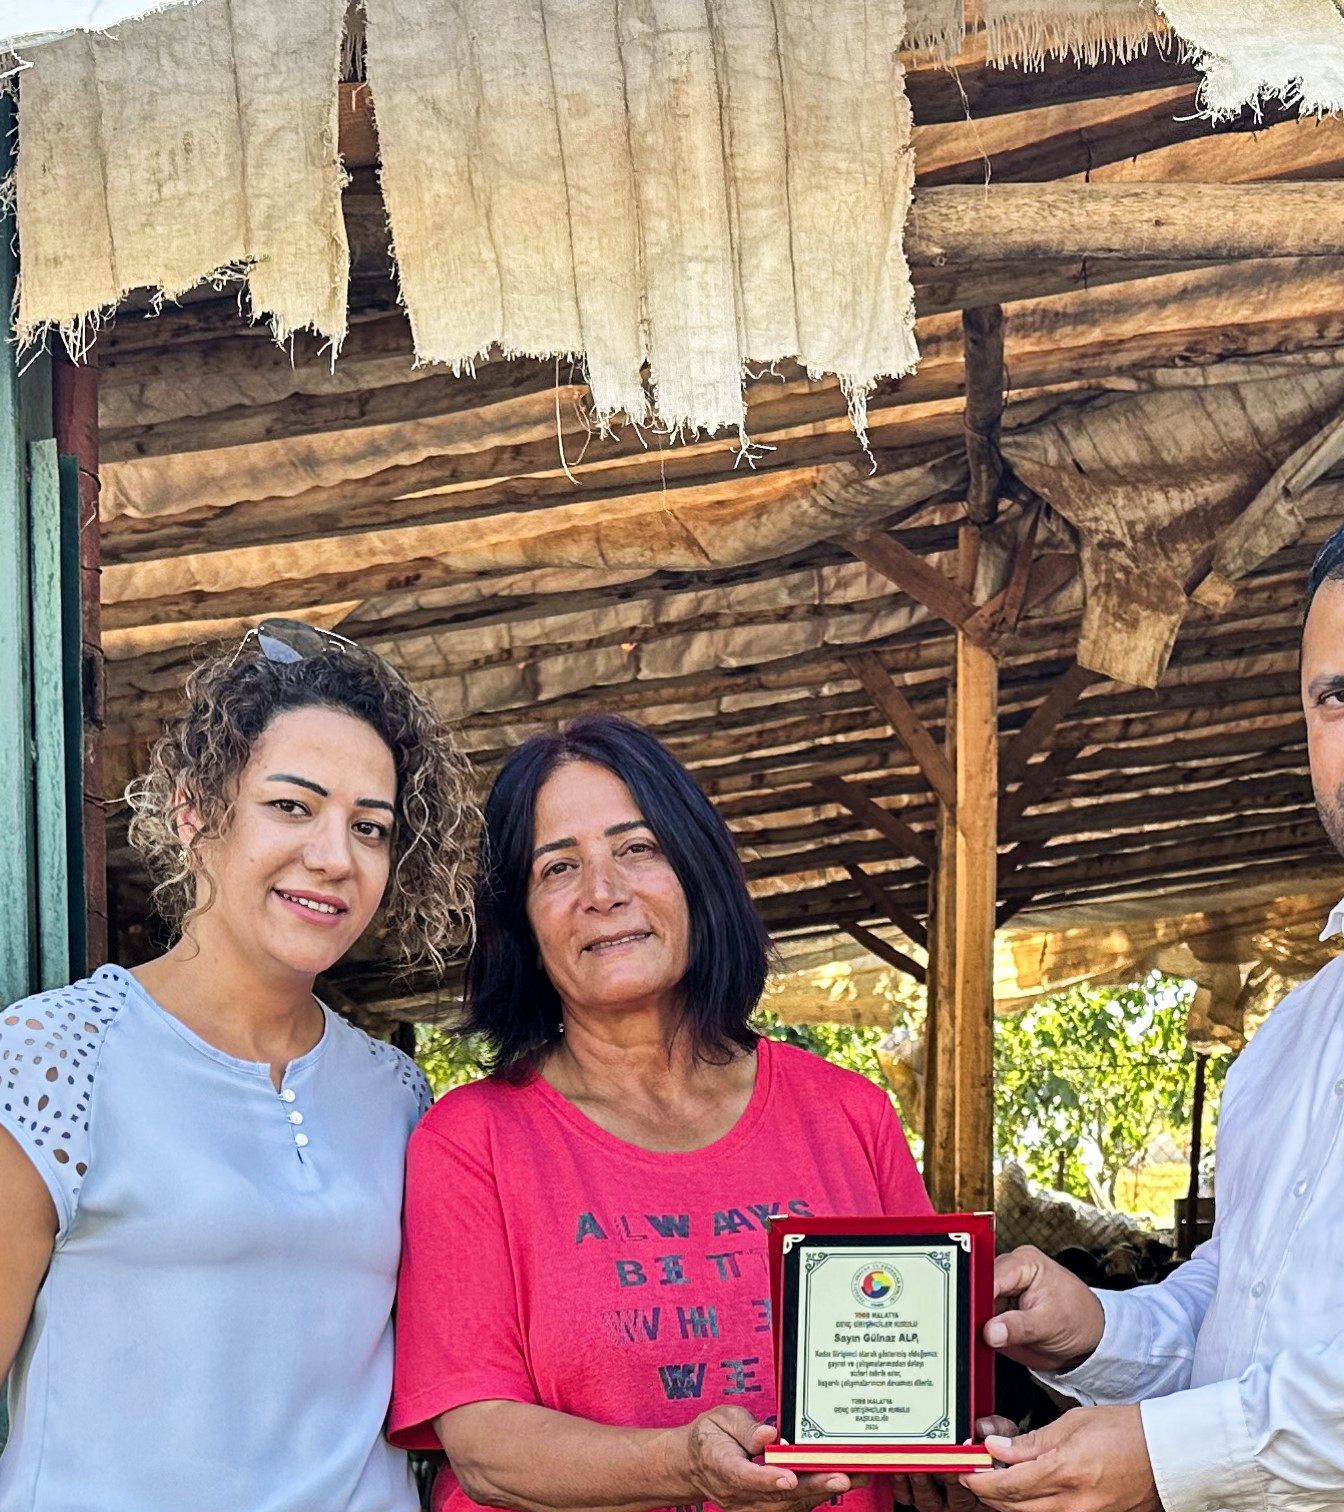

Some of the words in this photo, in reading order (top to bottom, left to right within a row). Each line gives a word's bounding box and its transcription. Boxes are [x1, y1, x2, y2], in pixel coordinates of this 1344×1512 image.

[833, 1333, 861, 1344] Sayın
[862, 1333, 896, 1343] Gülnaz
[898, 1333, 919, 1344] ALP,
